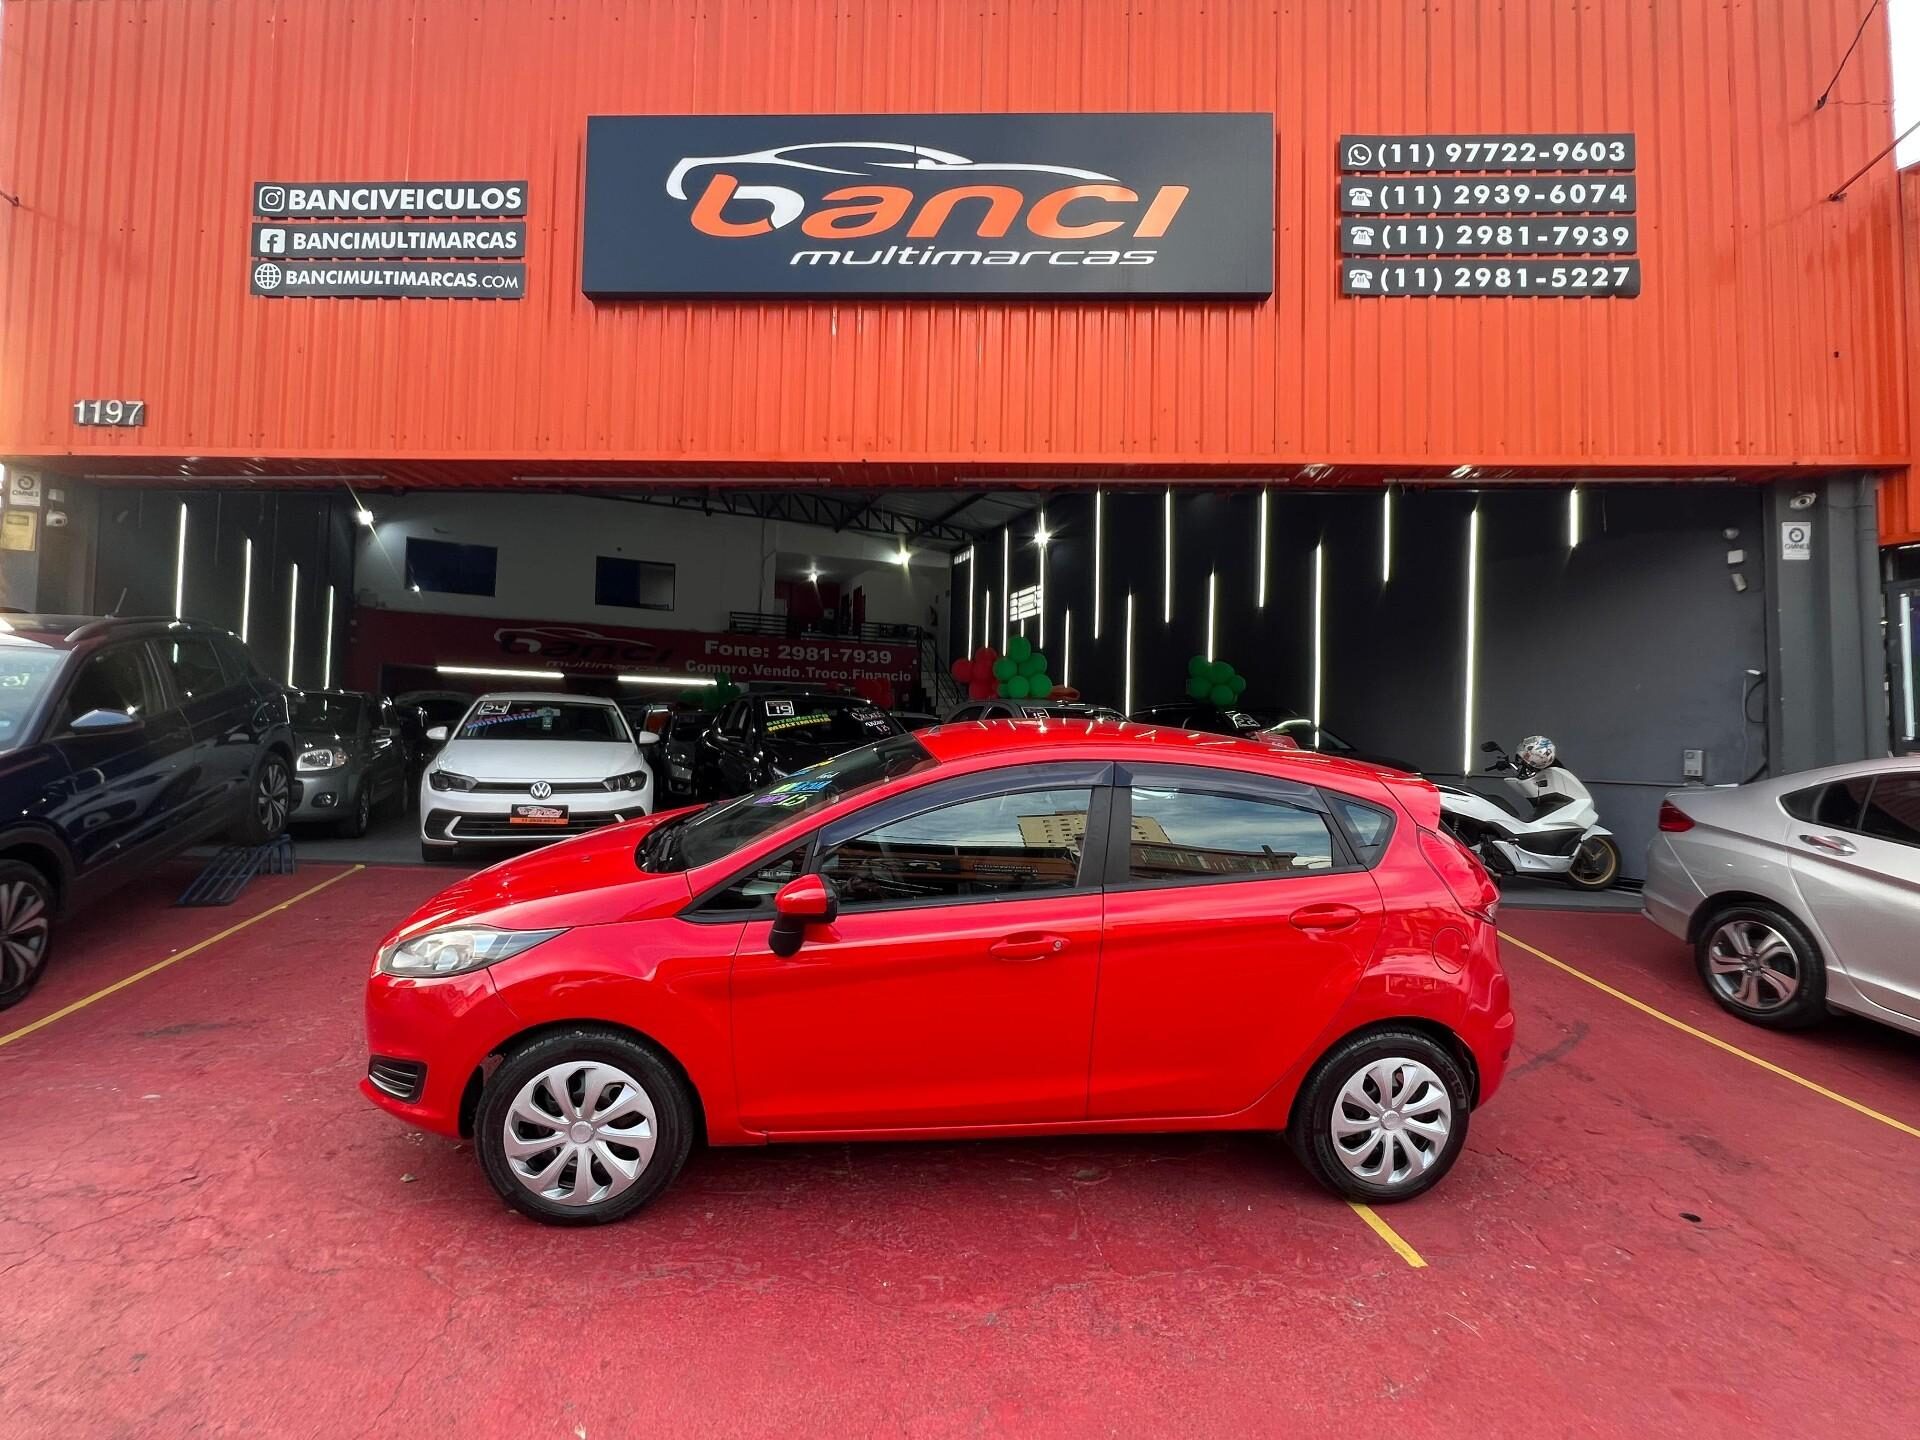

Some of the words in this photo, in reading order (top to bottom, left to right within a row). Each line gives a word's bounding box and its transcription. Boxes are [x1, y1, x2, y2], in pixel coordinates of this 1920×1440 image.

[1378, 143, 1435, 168] (11)
[1445, 142, 1626, 163] 97722-9603
[288, 187, 522, 211] BANCIVEICULOS
[690, 173, 1191, 239] banci
[1380, 185, 1442, 210] (11)
[1453, 183, 1628, 205] 2939-6074
[293, 231, 518, 251] BANCIMULTIMARCAS
[1382, 224, 1444, 250] (11)
[1456, 224, 1630, 246] 2981-7939
[789, 245, 1158, 266] multimarcas
[285, 270, 519, 289] BANCIMULTIMARCAS.COM
[1380, 267, 1443, 293] (11)
[1454, 266, 1630, 288] 2981-5227
[73, 400, 145, 425] 1197
[705, 640, 769, 658] Fone:
[777, 645, 892, 664] 2981-7939
[776, 705, 792, 714] 19
